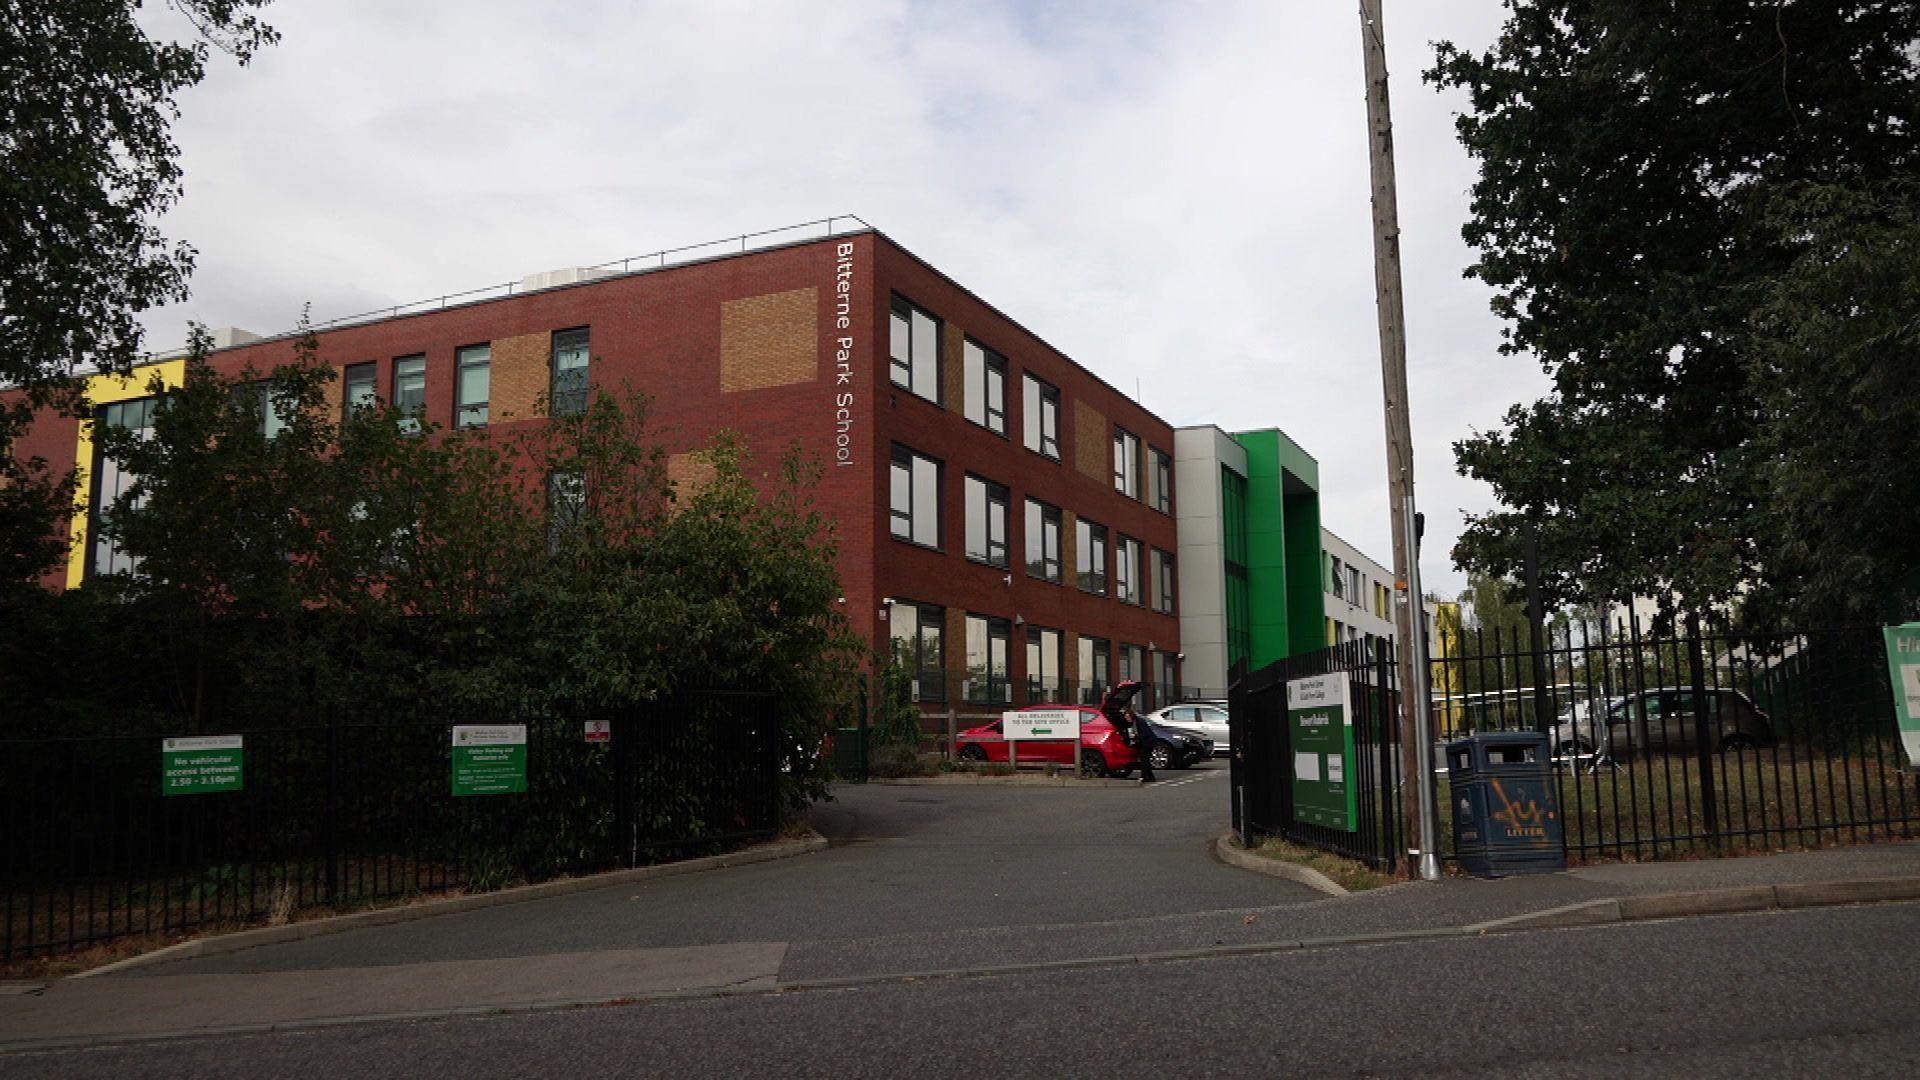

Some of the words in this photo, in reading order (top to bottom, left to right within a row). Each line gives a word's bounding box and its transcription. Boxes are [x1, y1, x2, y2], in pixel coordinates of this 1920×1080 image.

[836, 242, 853, 329] Bitterne
[837, 337, 853, 385] Park
[836, 393, 853, 466] School
[166, 769, 198, 777] access
[199, 765, 241, 775] between
[174, 757, 188, 766] No
[189, 755, 233, 765] vehicular
[1505, 828, 1545, 838] LITTER
